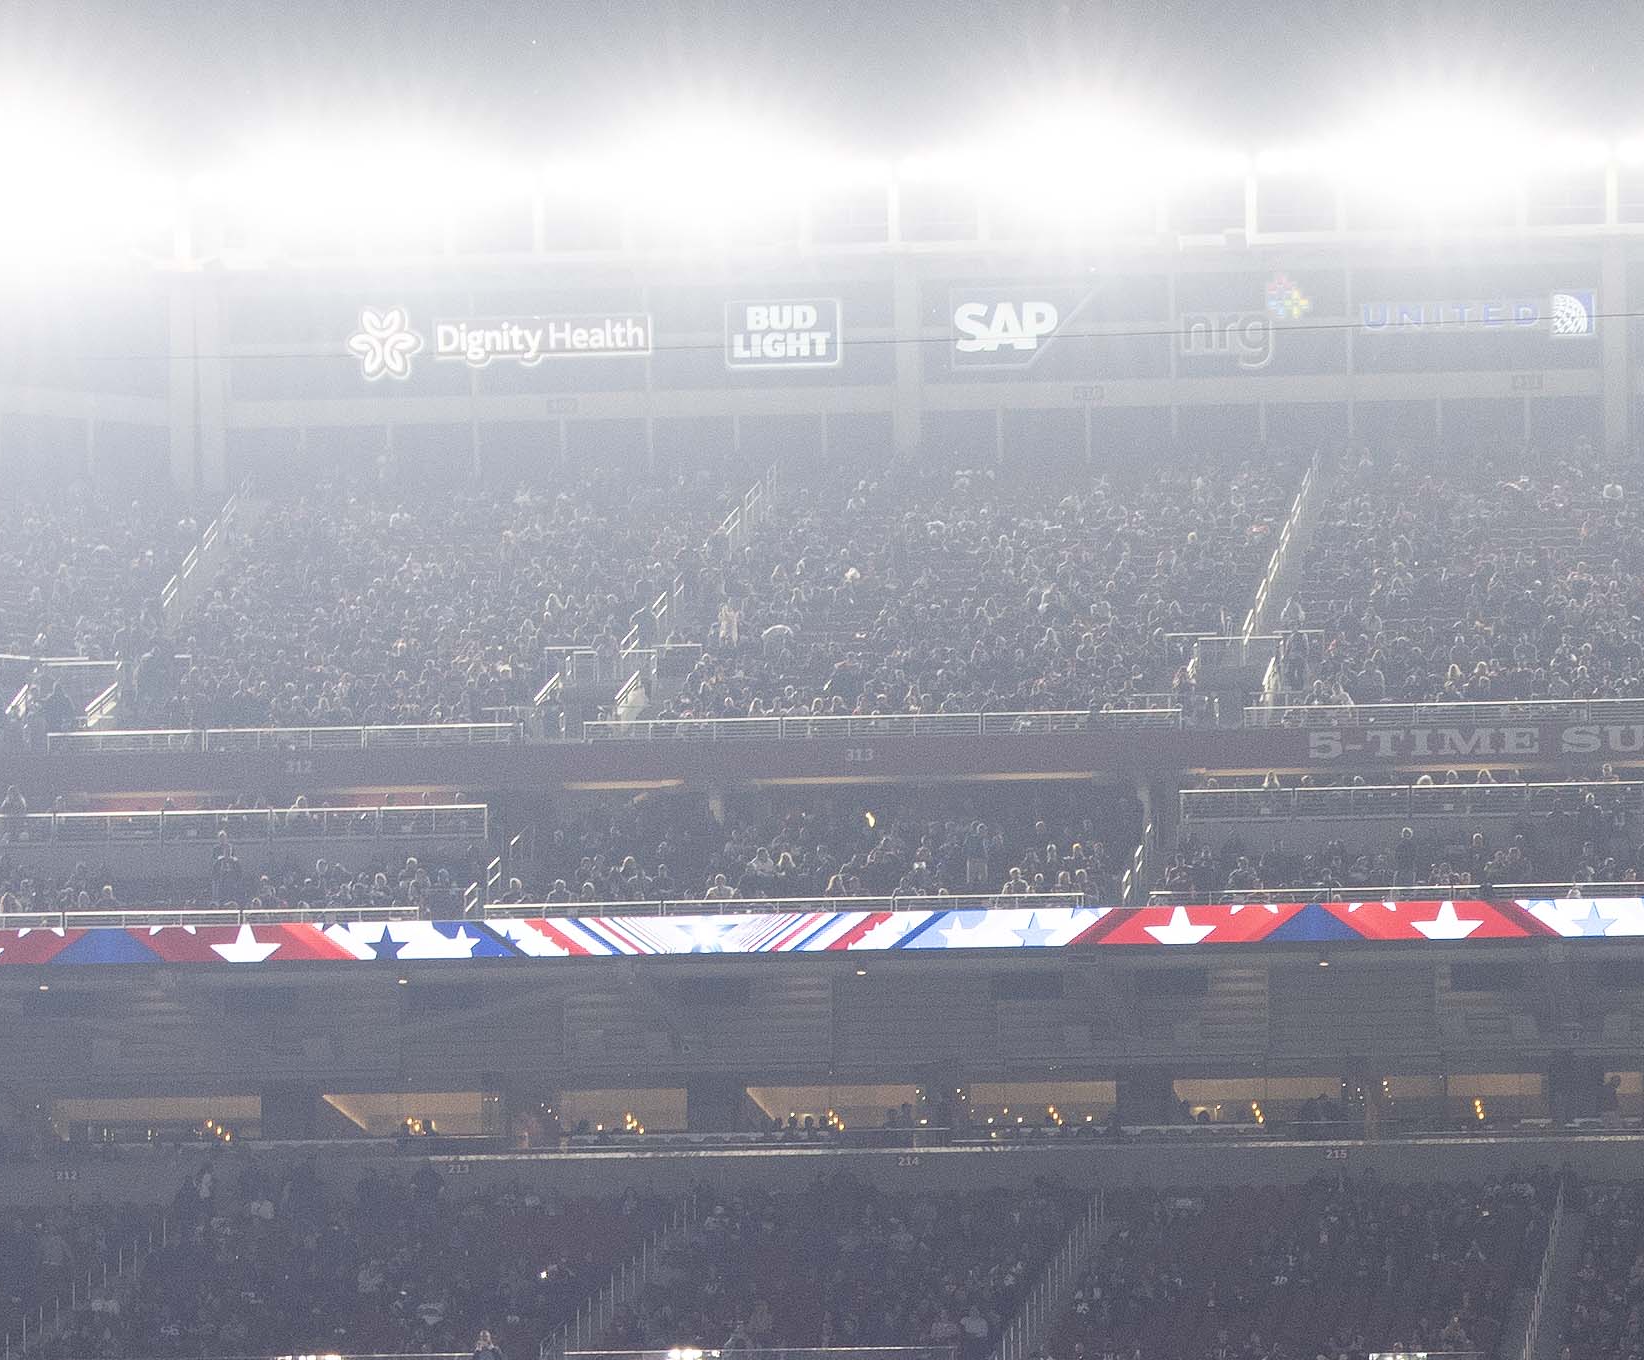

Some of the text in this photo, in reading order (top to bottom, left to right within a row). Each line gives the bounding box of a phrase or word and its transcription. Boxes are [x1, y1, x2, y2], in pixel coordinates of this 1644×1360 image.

[746, 305, 817, 330] BUD
[954, 302, 1058, 352] SAP
[1364, 302, 1539, 330] UNITED
[437, 319, 645, 359] Dignity Health
[733, 332, 831, 358] LIGHT
[1189, 317, 1274, 368] nrg
[845, 749, 875, 761] 313
[1308, 725, 1539, 760] 5-TIME
